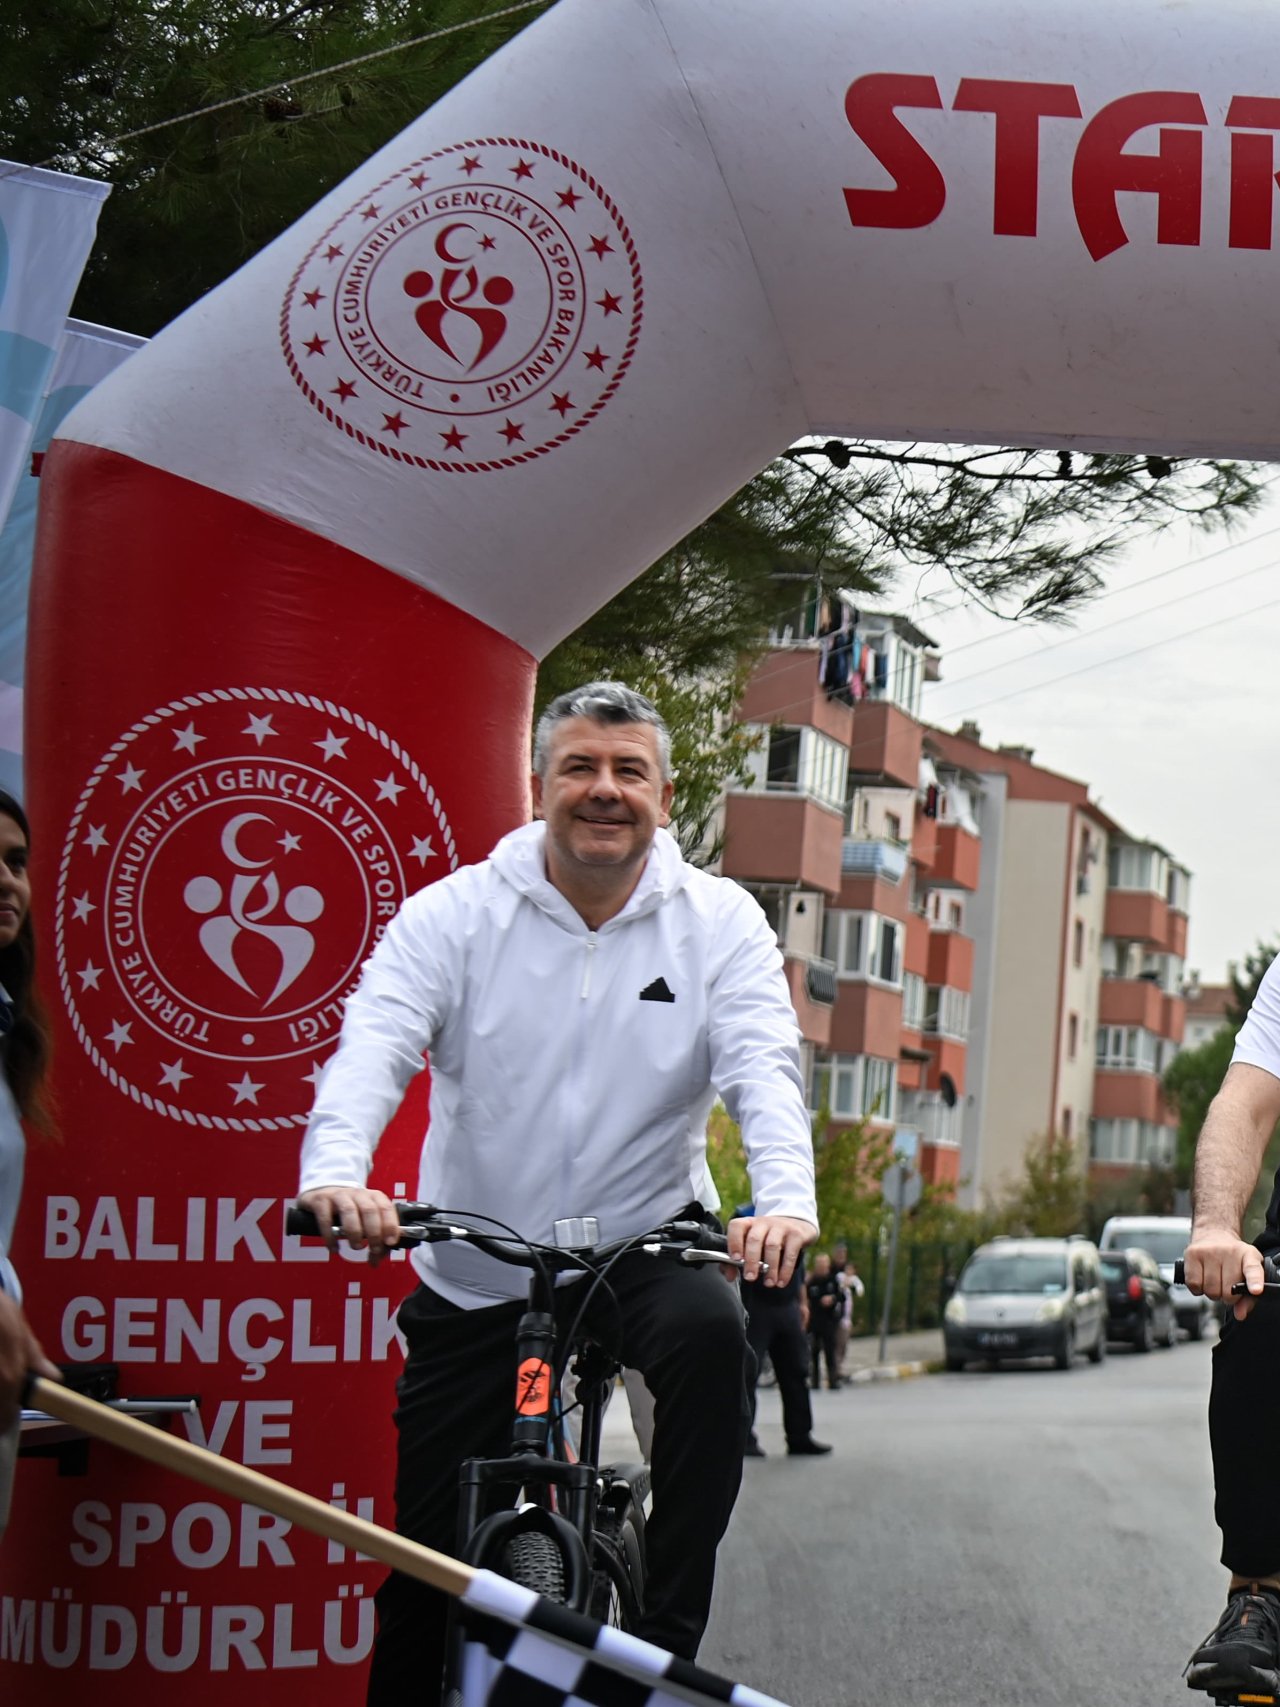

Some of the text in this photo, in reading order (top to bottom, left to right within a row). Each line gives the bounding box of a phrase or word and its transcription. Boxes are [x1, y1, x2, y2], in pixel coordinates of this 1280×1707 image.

[343, 191, 576, 403] TÜRKİYE CUMHURİYETİ GENÇLİK VE SPOR BAKANLIĞI
[216, 767, 342, 815] GENÇLİK
[340, 806, 374, 843] VE
[114, 773, 211, 947] CUMHURİYETİ
[362, 844, 397, 917] SPOR
[122, 951, 210, 1043] TÜRKİYE
[61, 1281, 409, 1380] GENÇLİK
[182, 1400, 293, 1465] VE
[69, 1501, 296, 1569] SPOR
